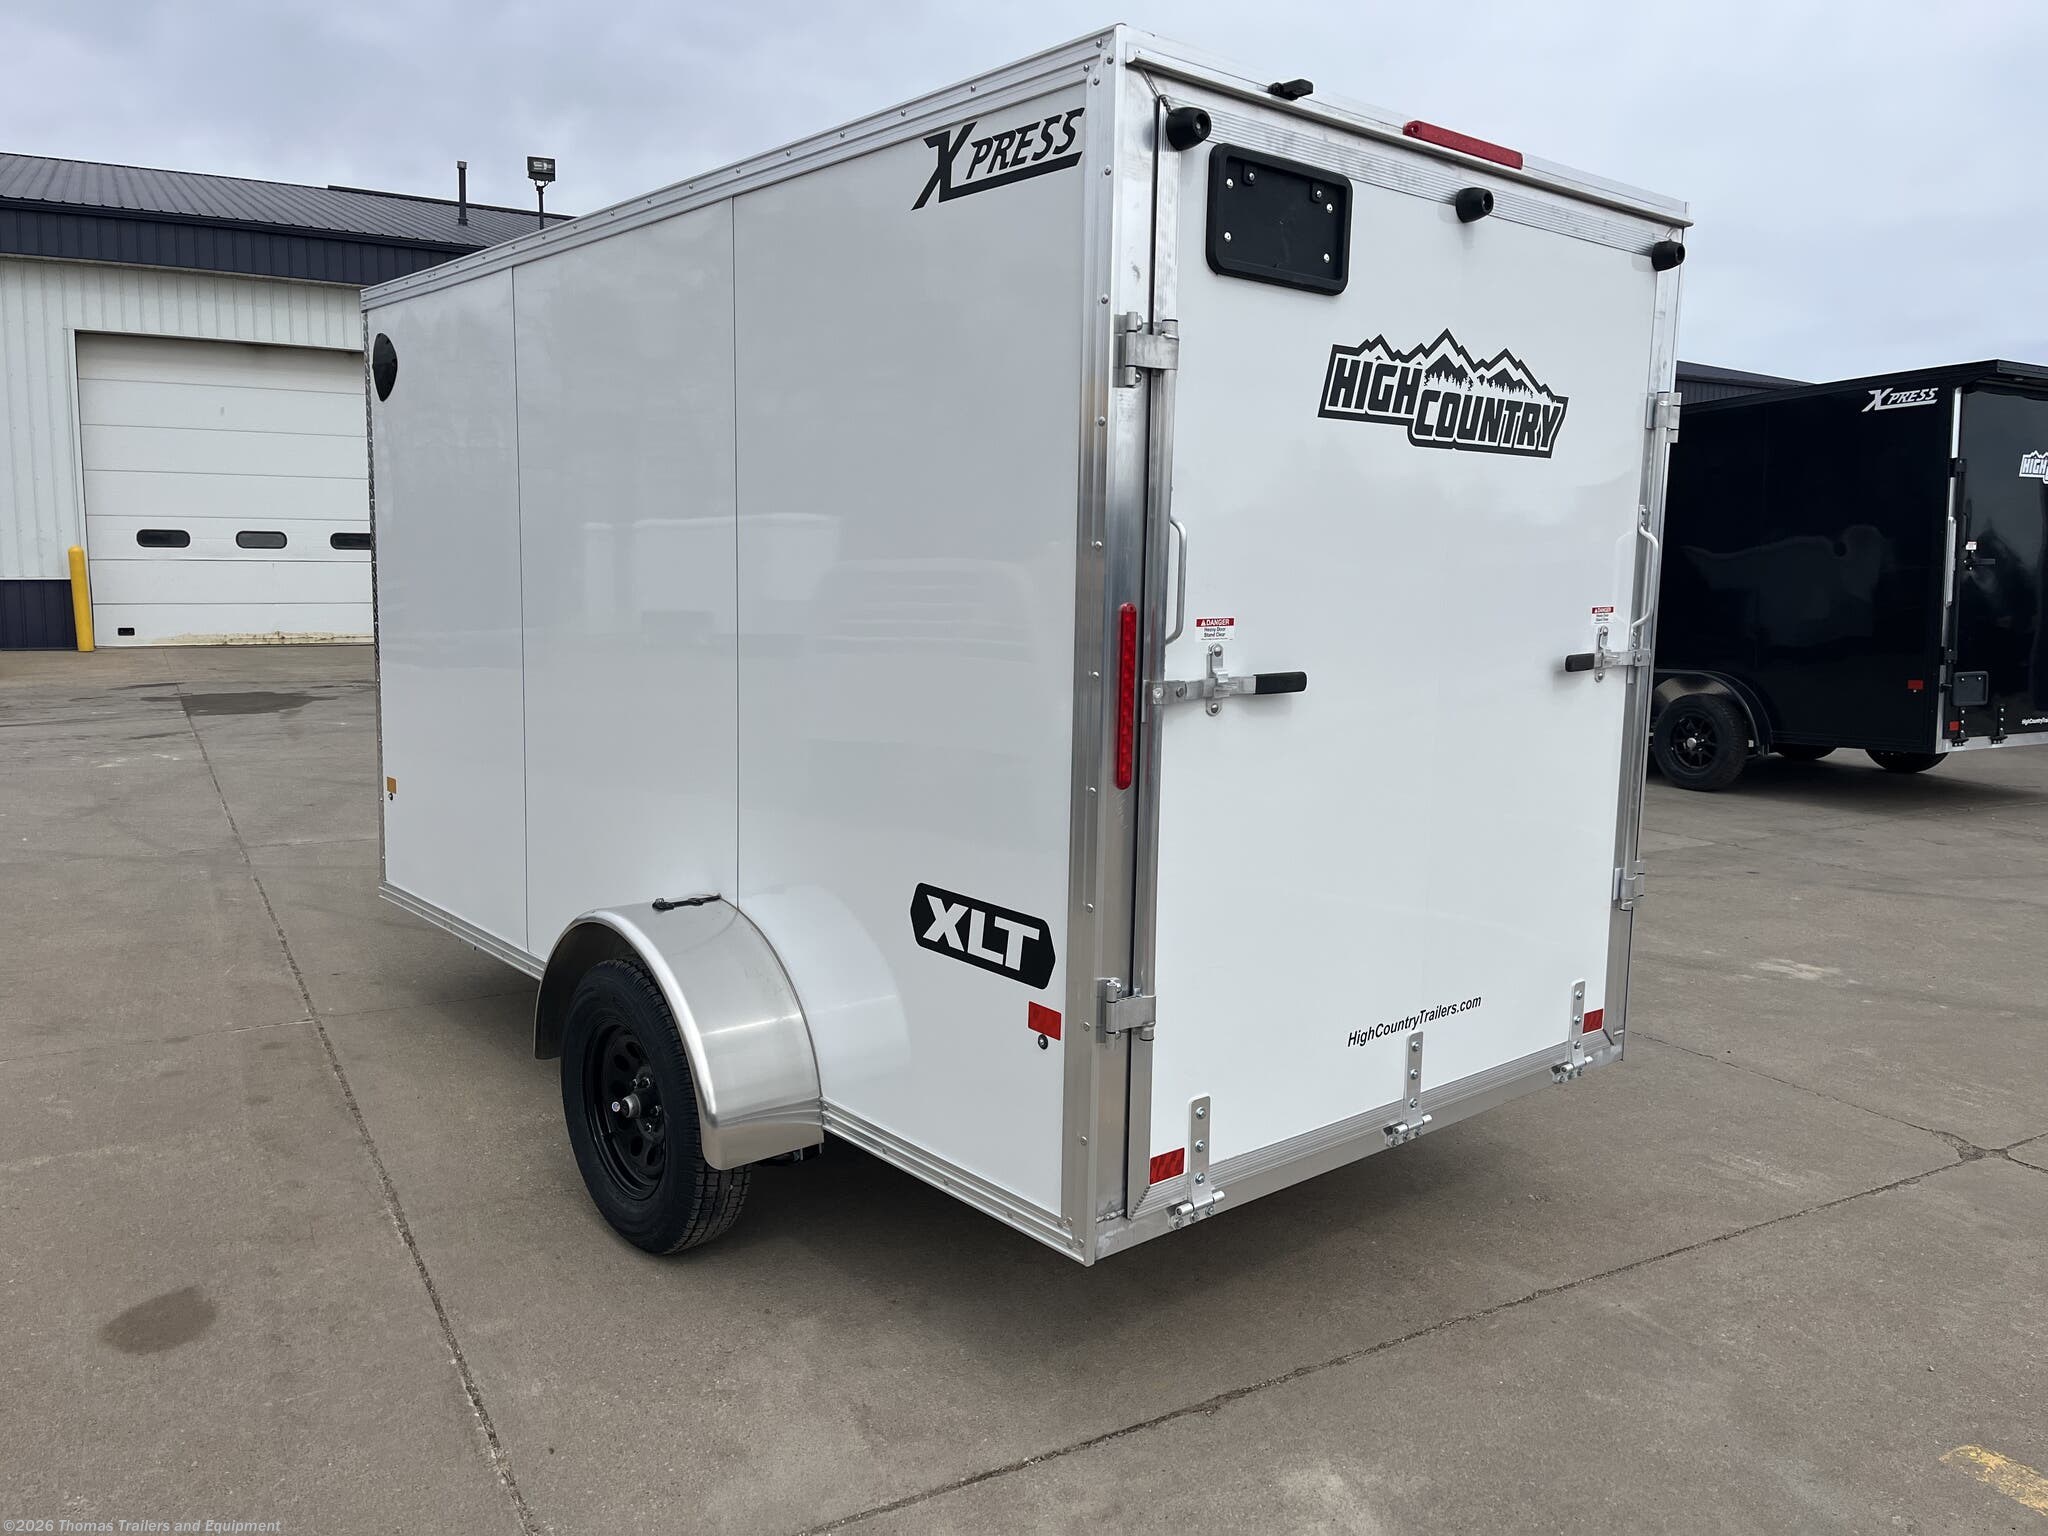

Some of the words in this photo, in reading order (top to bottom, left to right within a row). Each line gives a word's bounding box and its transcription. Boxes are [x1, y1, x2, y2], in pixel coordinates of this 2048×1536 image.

[911, 107, 1085, 211] XPRESS
[1327, 356, 1423, 415] HIGH
[1861, 387, 1939, 412] XPRESS
[1414, 388, 1561, 449] COUNTRY
[2022, 458, 2047, 475] HIGH
[1206, 618, 1230, 626] DANGER
[922, 894, 1041, 972] XLT
[1347, 996, 1482, 1047] HighCountryTrailers.com
